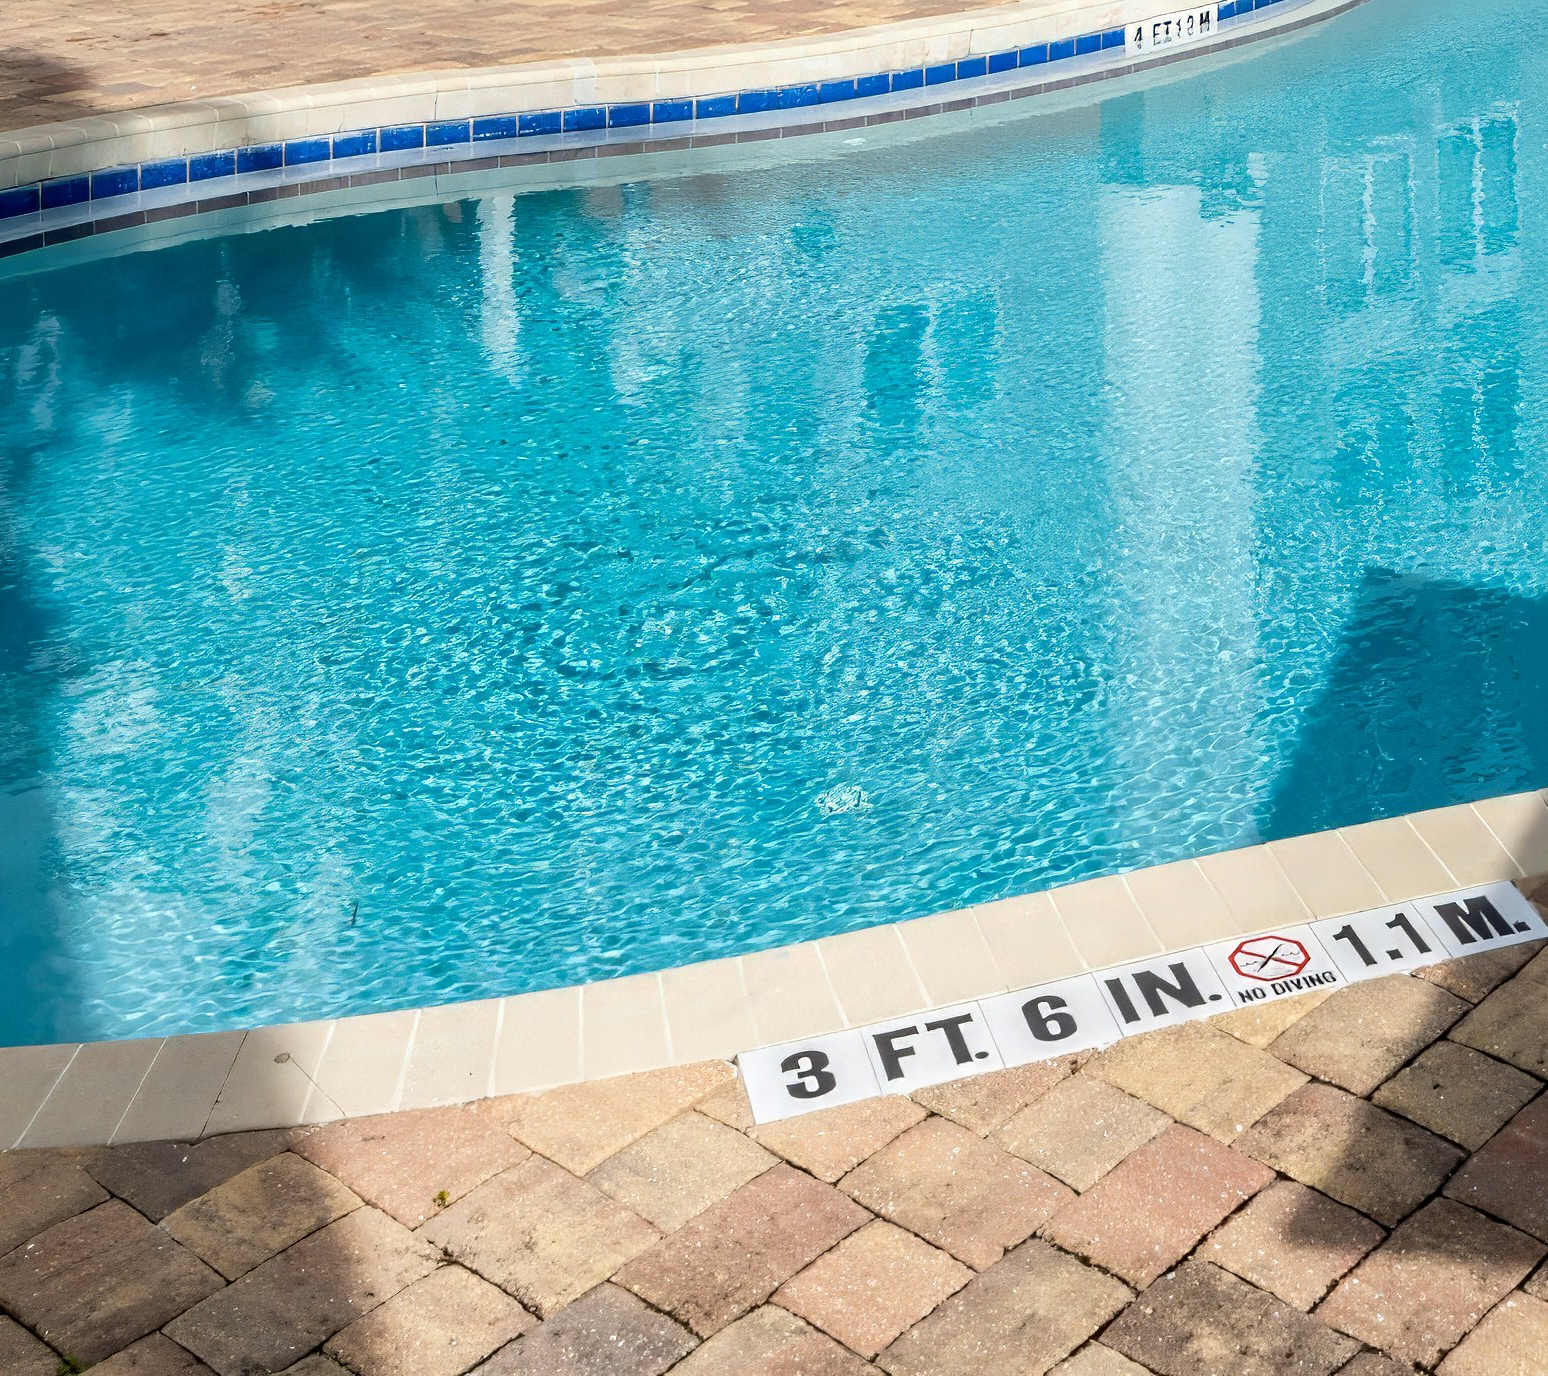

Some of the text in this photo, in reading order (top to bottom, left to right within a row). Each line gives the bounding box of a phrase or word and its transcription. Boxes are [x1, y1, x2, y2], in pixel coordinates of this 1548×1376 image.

[780, 893, 1533, 1101] 3 FT. 6 IN. 1.1 M.
[1238, 970, 1337, 1004] NO DIVING
